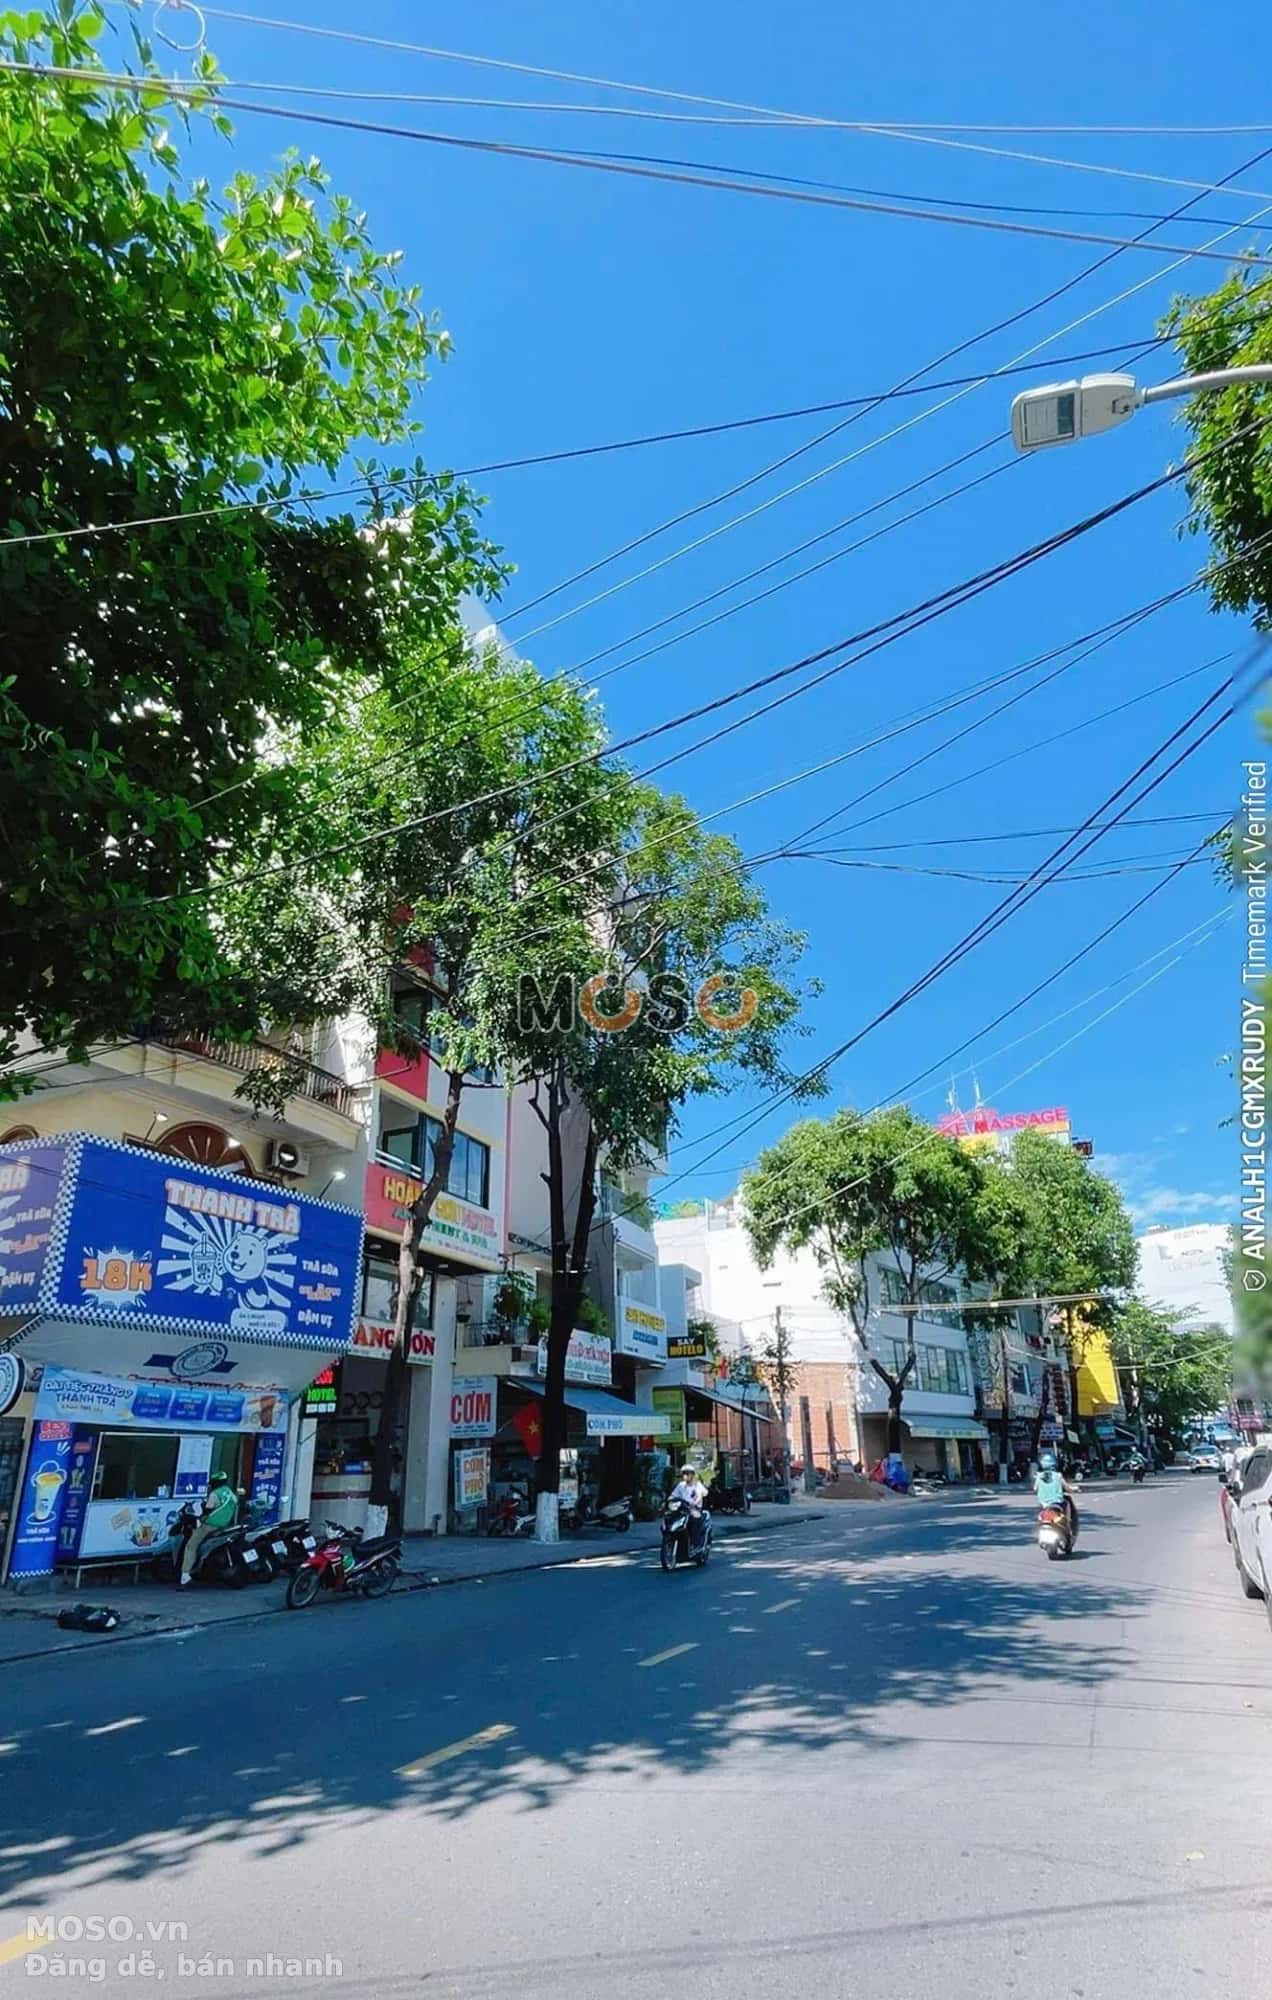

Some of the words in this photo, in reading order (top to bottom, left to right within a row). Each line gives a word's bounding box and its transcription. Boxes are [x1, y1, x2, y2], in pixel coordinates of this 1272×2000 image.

[973, 1104, 1068, 1135] MASSAGE
[165, 1178, 255, 1224] THANH
[80, 1258, 152, 1292] 18K
[408, 1330, 436, 1356] ƠN
[56, 1392, 95, 1404] THANH
[451, 1391, 491, 1424] CƠM
